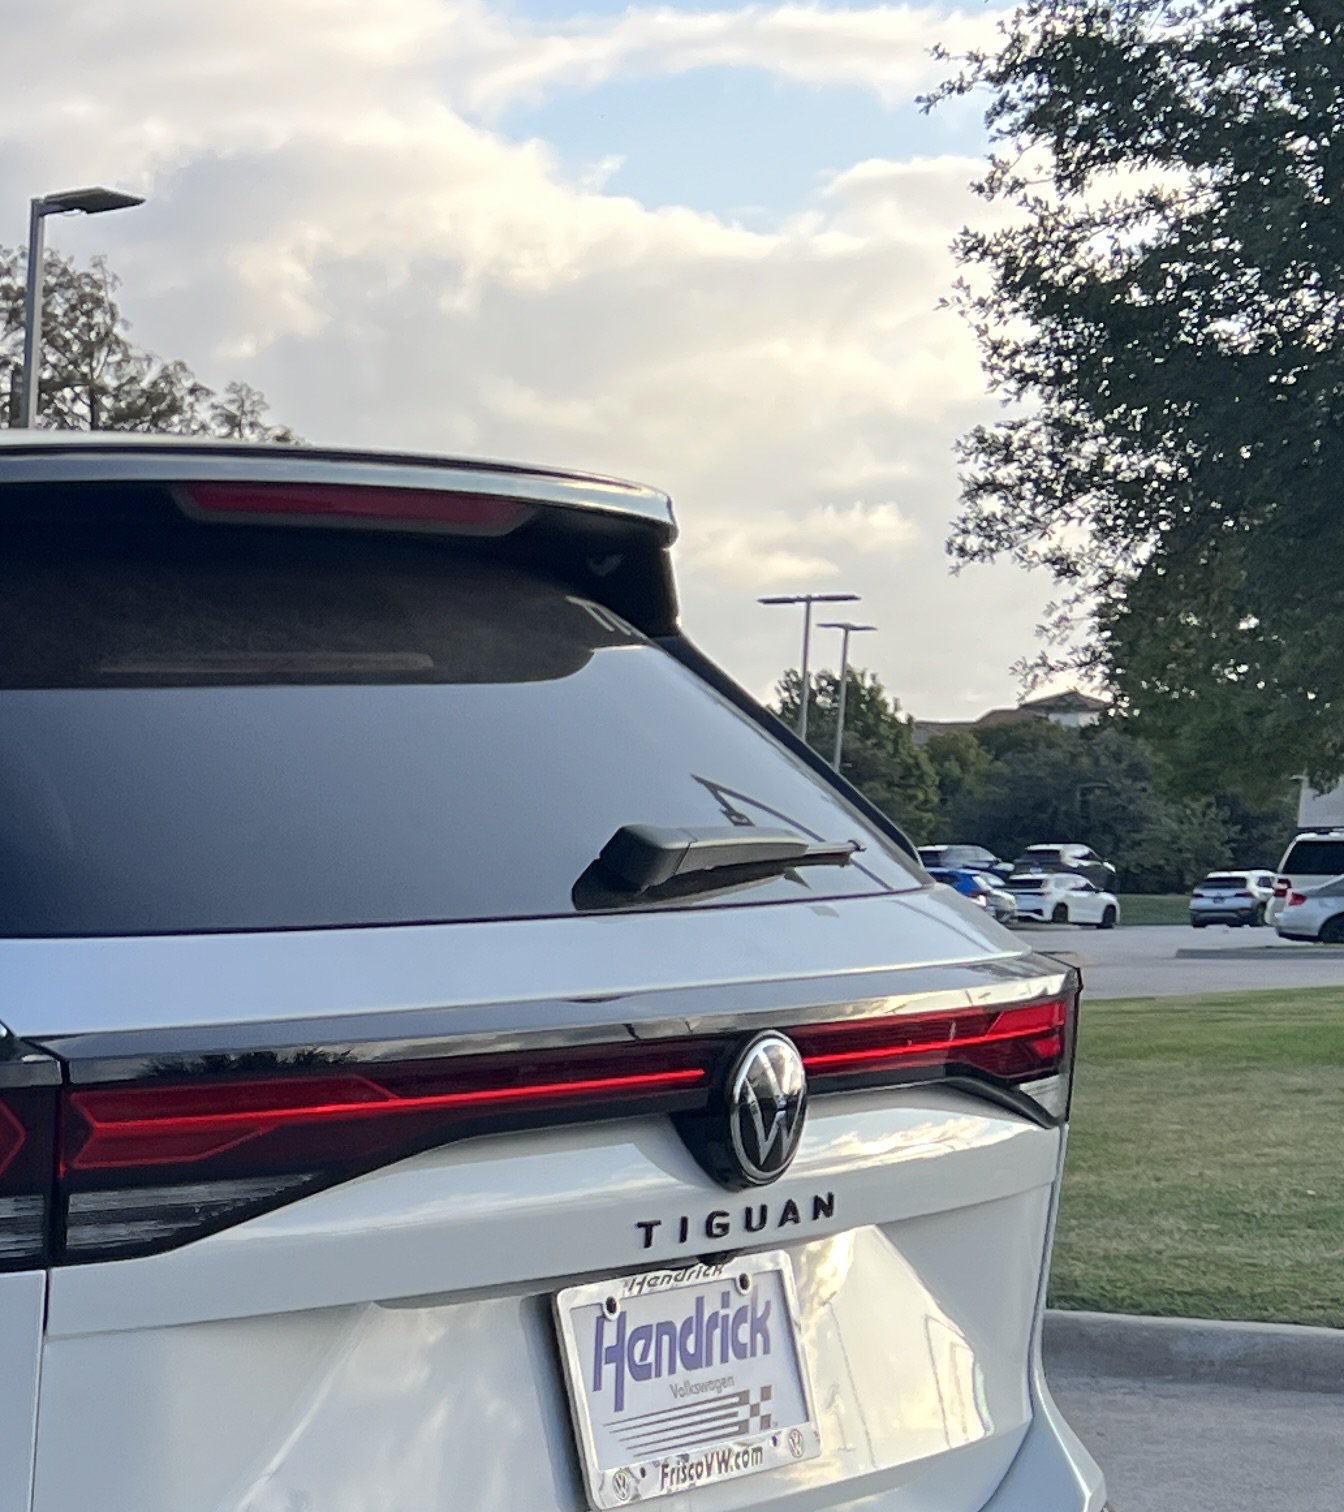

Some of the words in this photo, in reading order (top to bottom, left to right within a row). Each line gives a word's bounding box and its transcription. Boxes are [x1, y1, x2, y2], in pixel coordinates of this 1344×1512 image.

[637, 1192, 834, 1248] TIGUAN
[627, 1264, 724, 1295] Hendrick
[592, 1285, 771, 1412] Hendrick
[661, 1447, 763, 1490] FriscoVW.com
